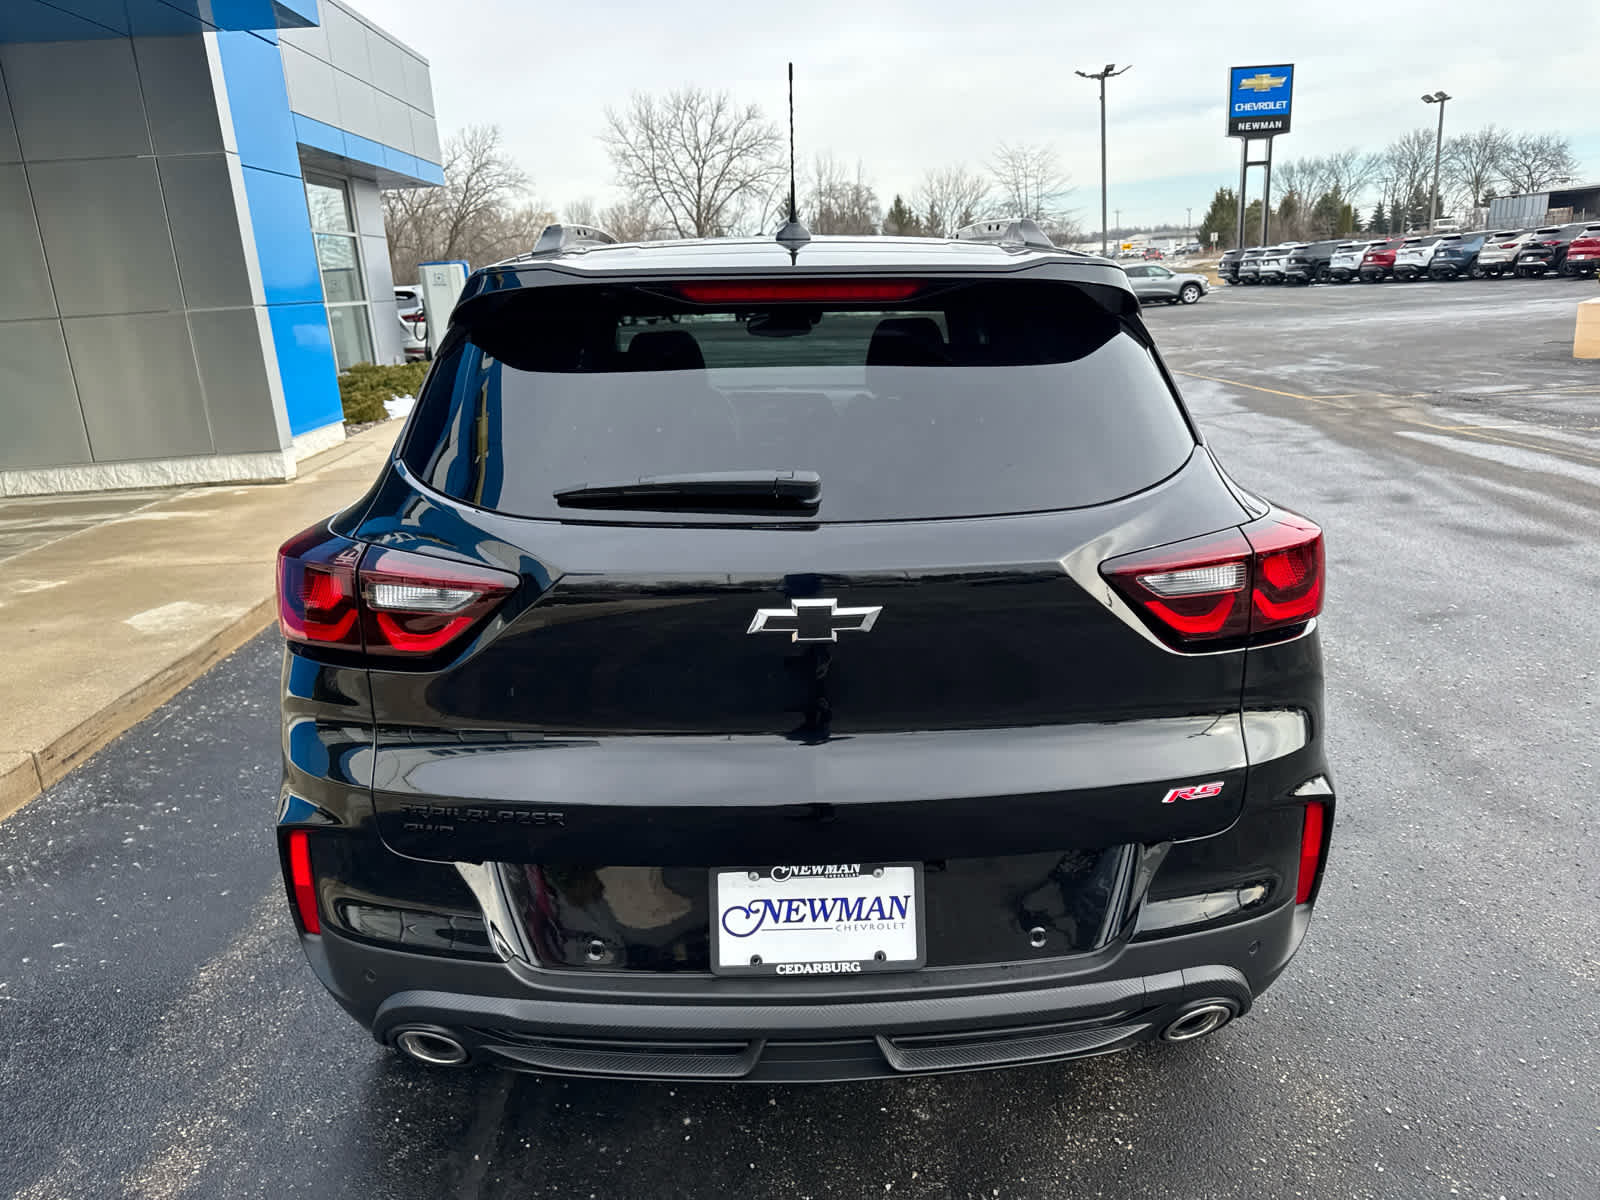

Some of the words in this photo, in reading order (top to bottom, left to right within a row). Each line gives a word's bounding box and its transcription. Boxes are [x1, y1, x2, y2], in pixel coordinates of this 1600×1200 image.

[1234, 100, 1289, 112] CHEVROLET
[1238, 120, 1282, 131] NEWMAN
[1161, 780, 1225, 804] RS
[770, 863, 861, 883] NEWMAN
[721, 895, 911, 938] NEWMAN
[834, 922, 906, 933] CHEVROLET
[775, 961, 862, 975] CEDARBURG
